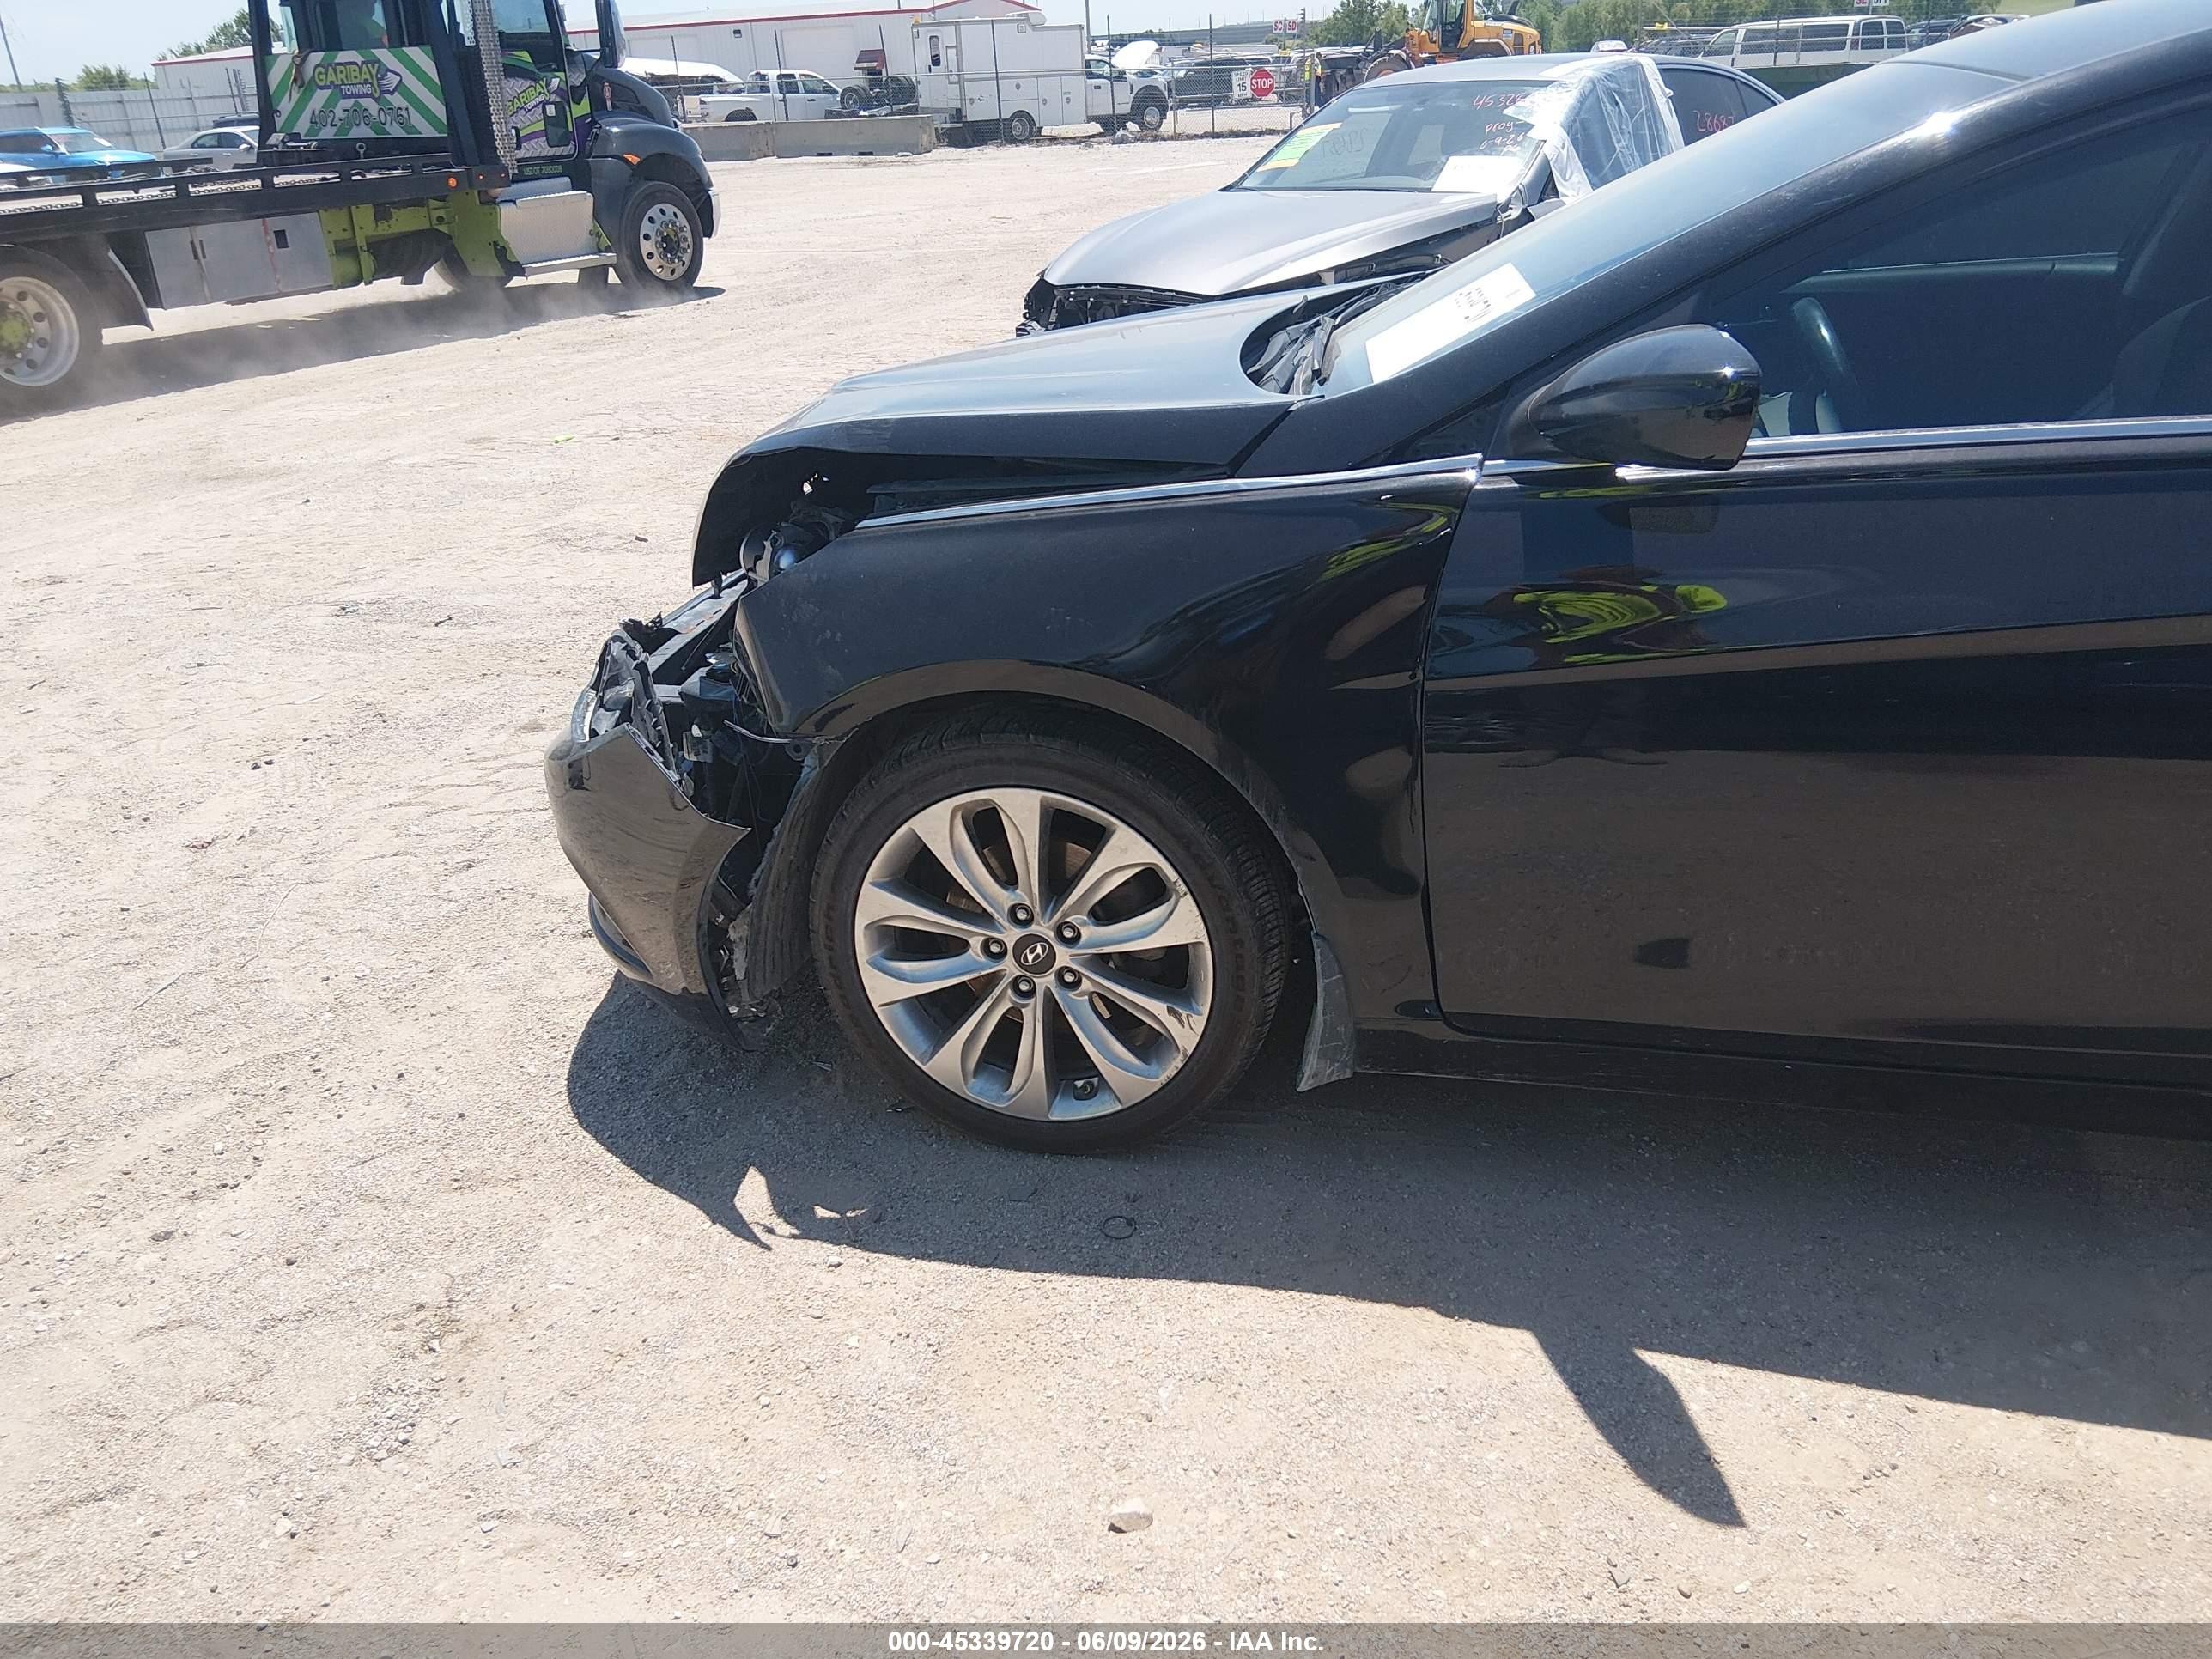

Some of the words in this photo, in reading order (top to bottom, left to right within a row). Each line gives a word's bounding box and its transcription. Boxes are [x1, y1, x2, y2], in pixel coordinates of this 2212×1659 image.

[1273, 21, 1283, 31] SC
[1287, 21, 1297, 31] SD
[314, 62, 379, 98] GARIBAY
[1251, 78, 1273, 89] STOP
[341, 84, 372, 95] TOWING
[1237, 82, 1247, 92] 15
[523, 94, 545, 112] TOWING
[310, 106, 413, 129] 402-706-0761
